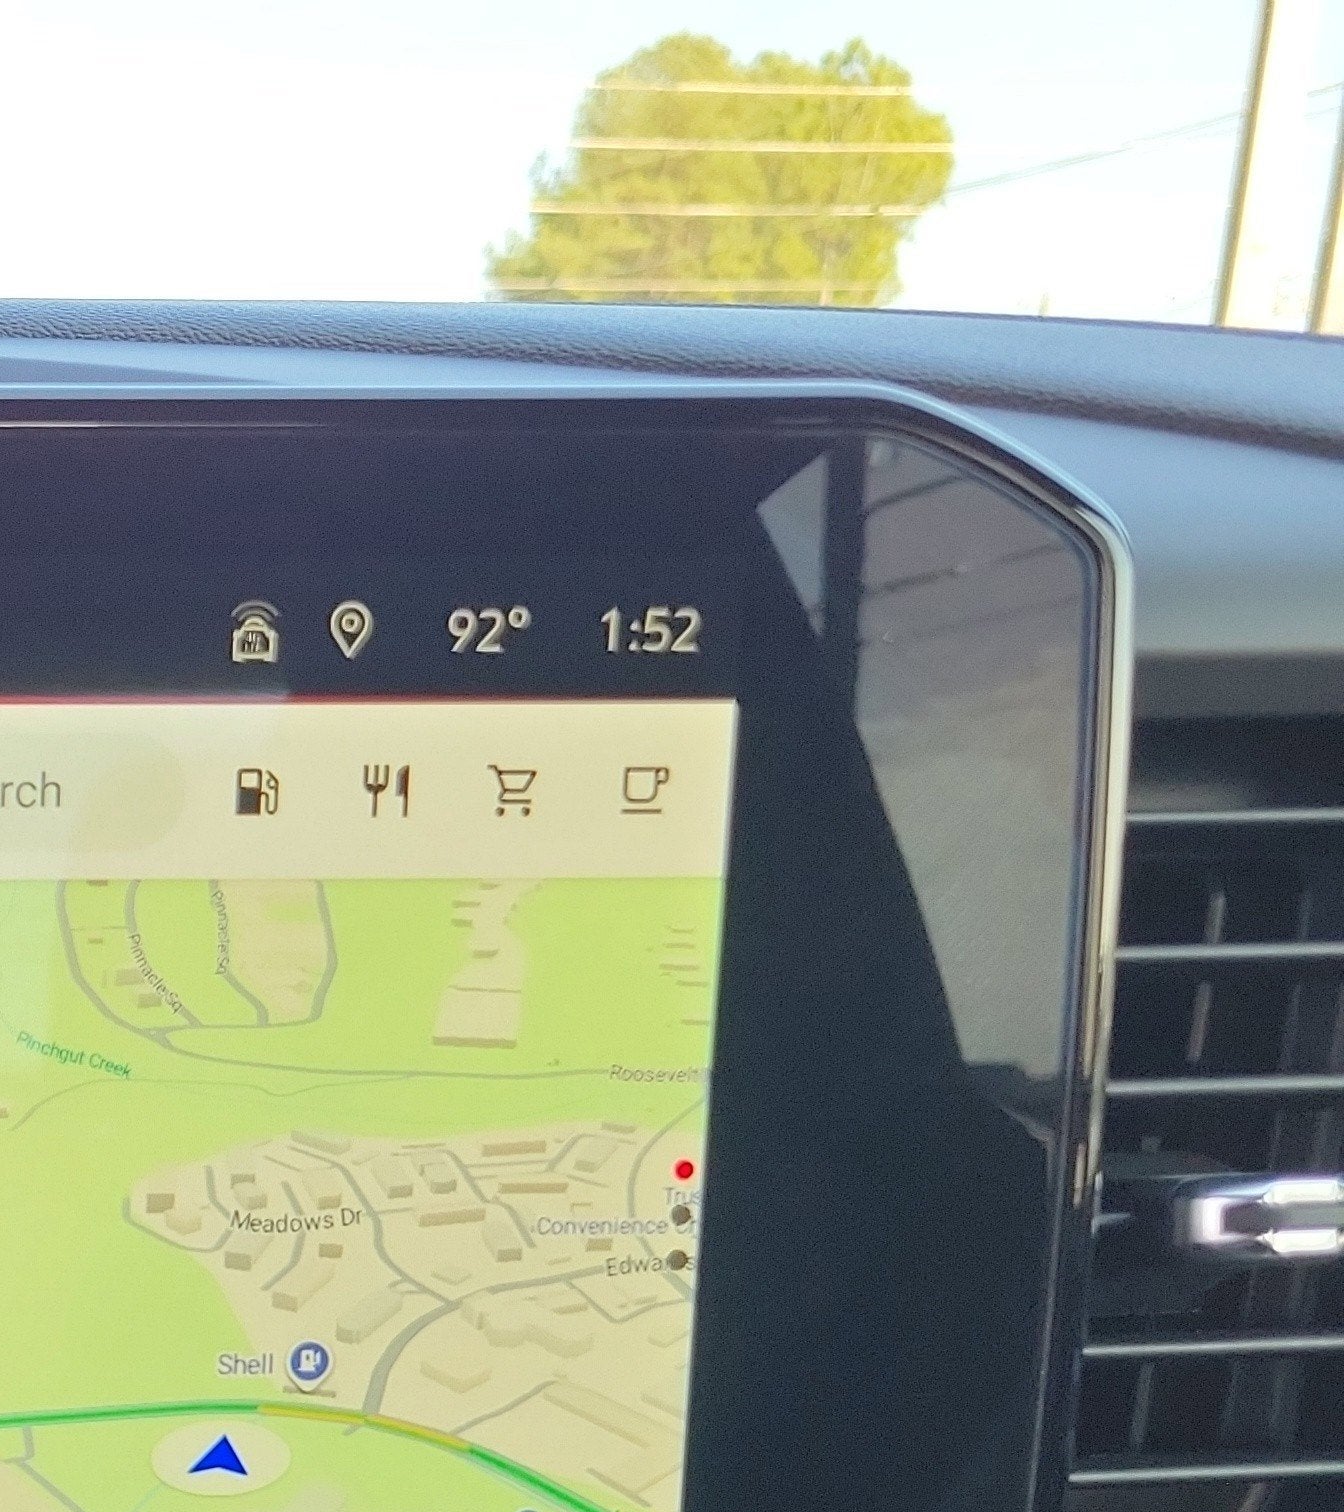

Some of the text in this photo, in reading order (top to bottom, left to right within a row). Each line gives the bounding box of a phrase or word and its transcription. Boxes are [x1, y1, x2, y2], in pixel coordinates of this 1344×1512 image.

[448, 606, 532, 653] 92°
[601, 607, 702, 652] 1:52
[211, 890, 230, 954] Pinnacle
[128, 933, 183, 1014] Pinnacle Sq
[16, 1029, 132, 1079] Pinchgut Creek
[229, 1207, 363, 1234] Meadows Dr
[537, 1216, 669, 1235] Convenience
[218, 1353, 274, 1375] Shell
